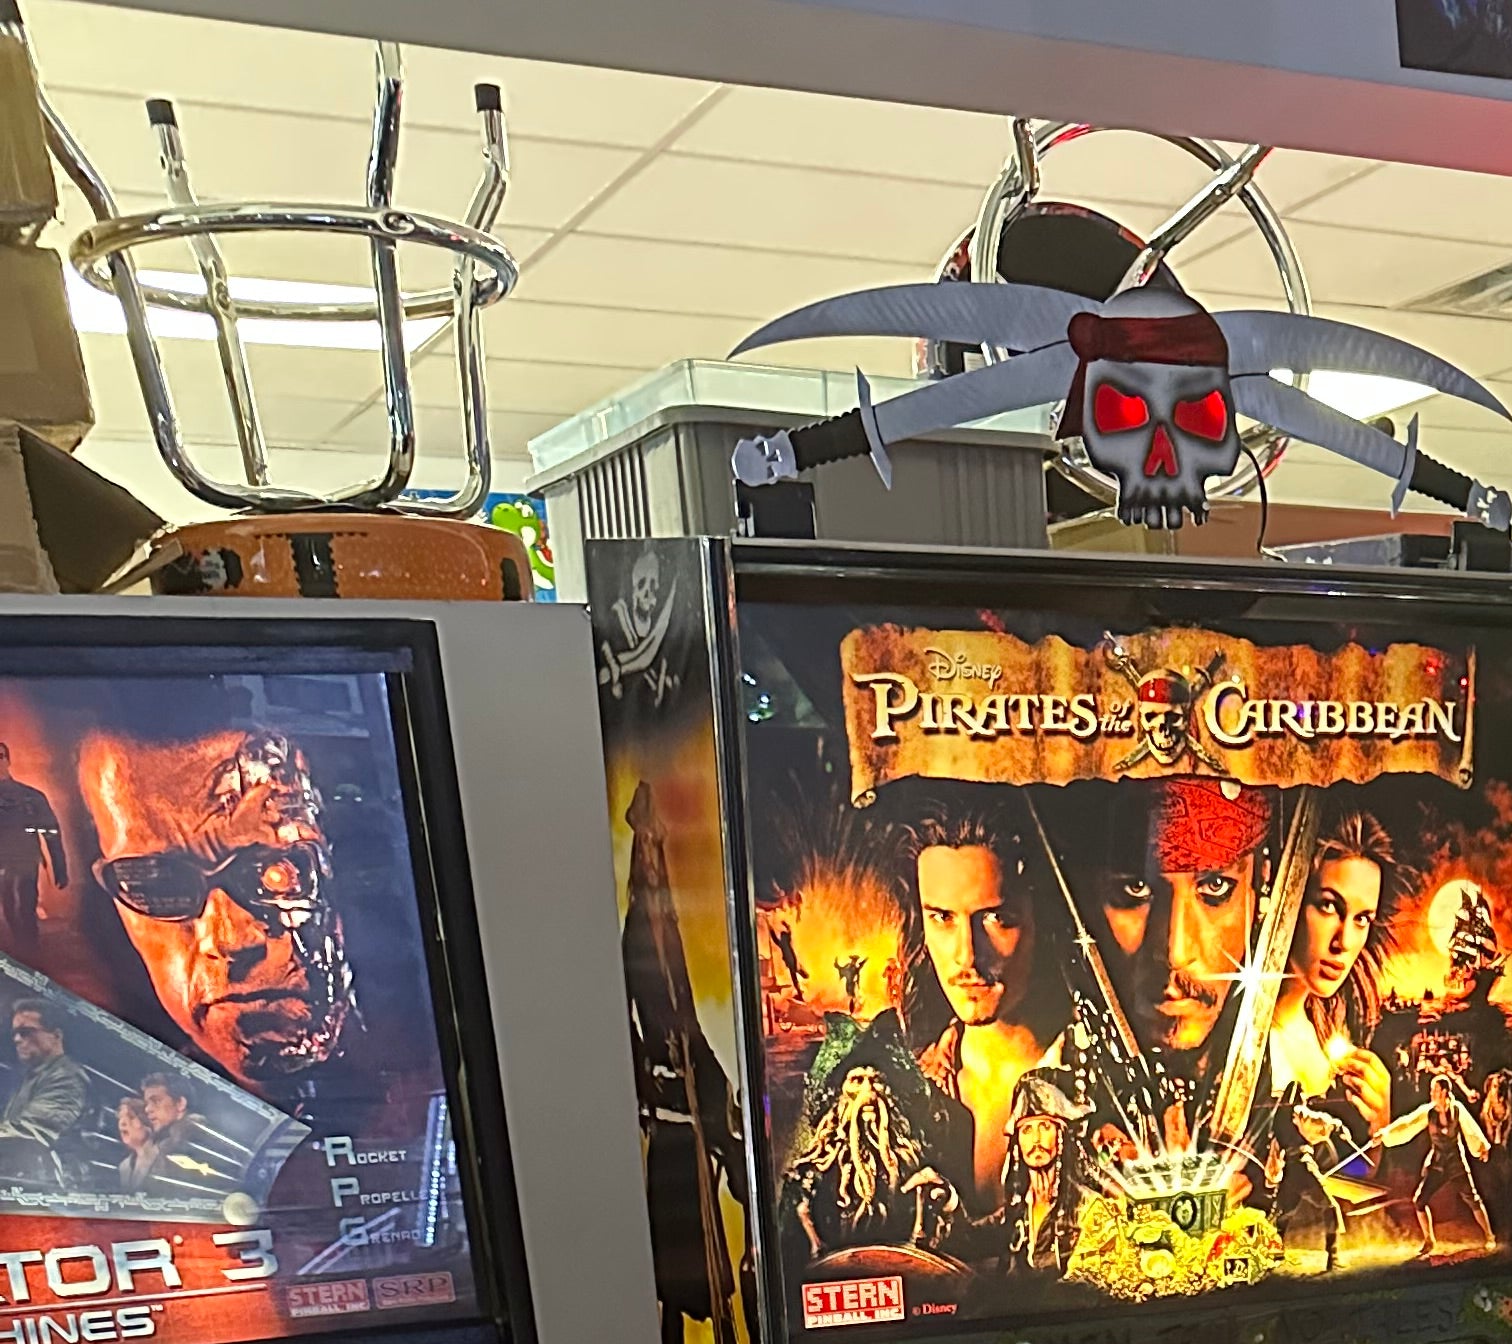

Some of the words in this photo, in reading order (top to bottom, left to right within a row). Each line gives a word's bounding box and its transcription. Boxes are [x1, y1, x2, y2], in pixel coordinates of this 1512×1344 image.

[853, 672, 1097, 740] PIRATES
[1204, 681, 1462, 743] CARIBBEAN
[0, 1237, 183, 1302] TOR
[213, 1230, 279, 1281] 3
[290, 1280, 366, 1306] STERN
[808, 1281, 900, 1312] STERN
